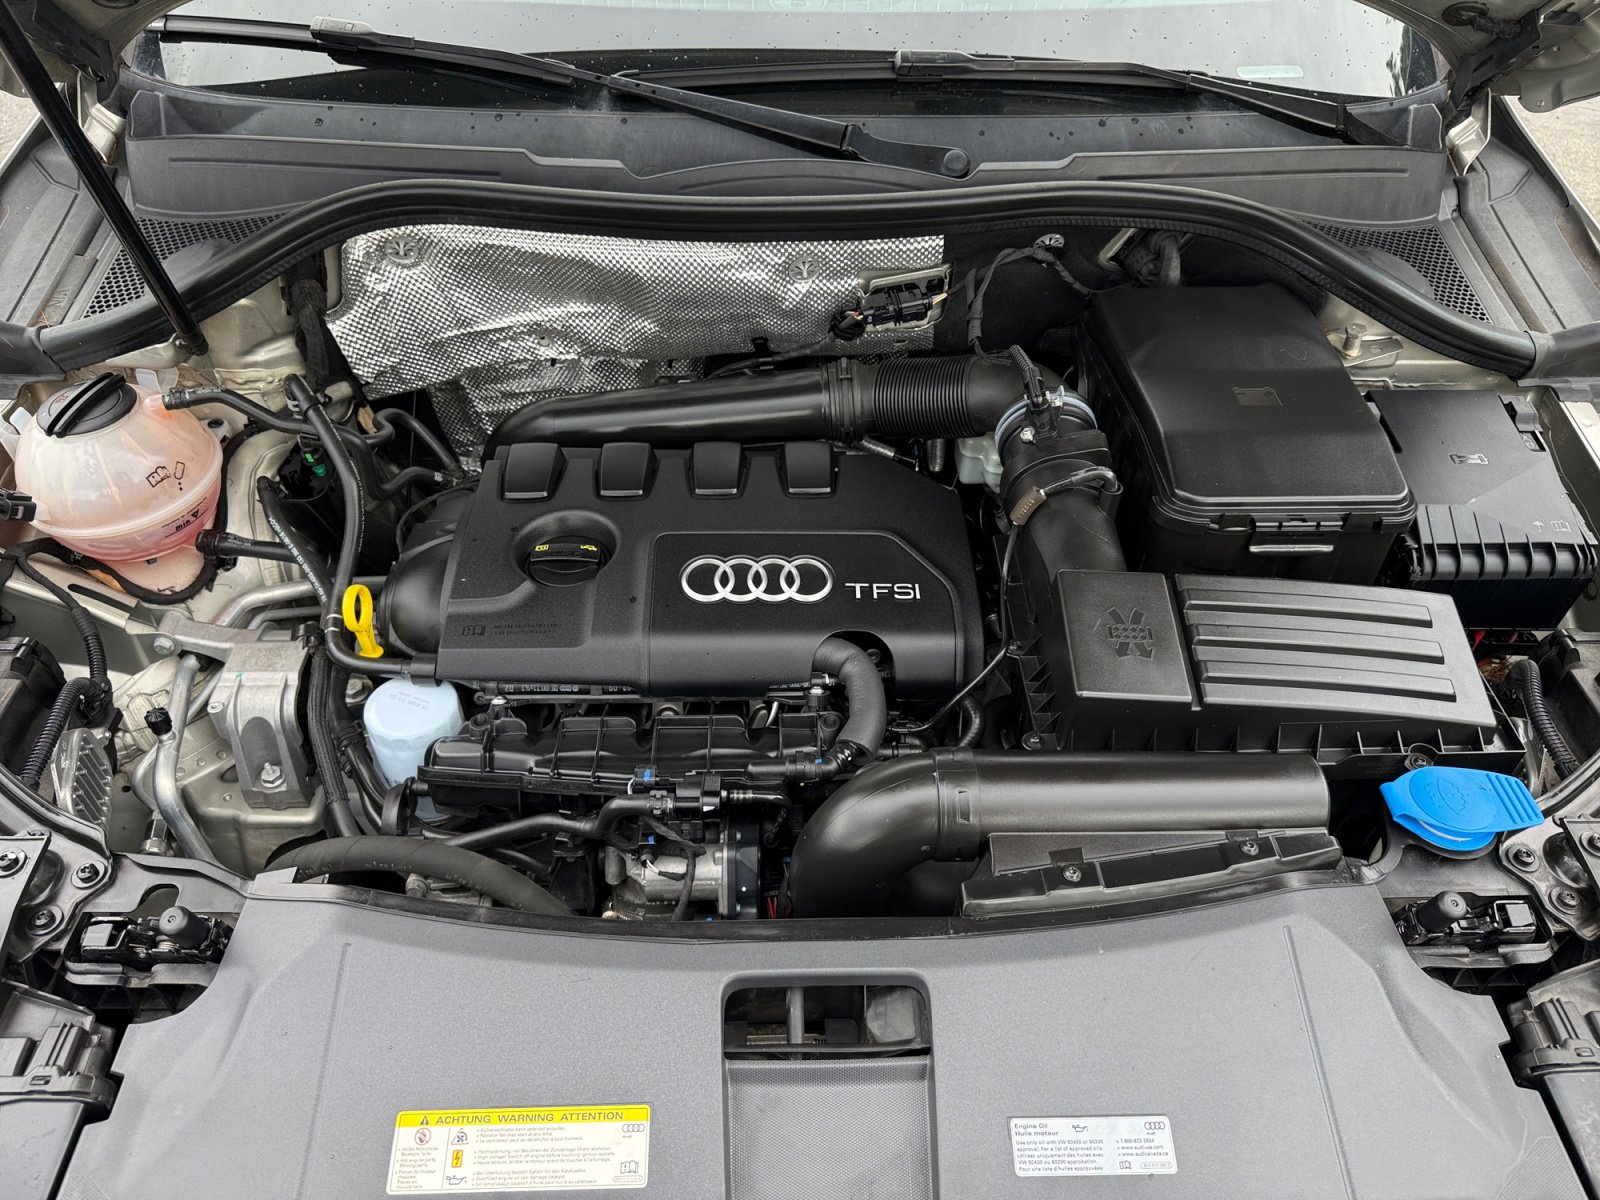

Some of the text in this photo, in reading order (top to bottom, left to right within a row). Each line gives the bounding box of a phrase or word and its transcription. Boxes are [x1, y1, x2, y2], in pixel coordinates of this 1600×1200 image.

[176, 519, 191, 532] min
[845, 583, 921, 600] TFSI
[436, 1111, 624, 1125] ACHTUNG WARNING ATTENTION
